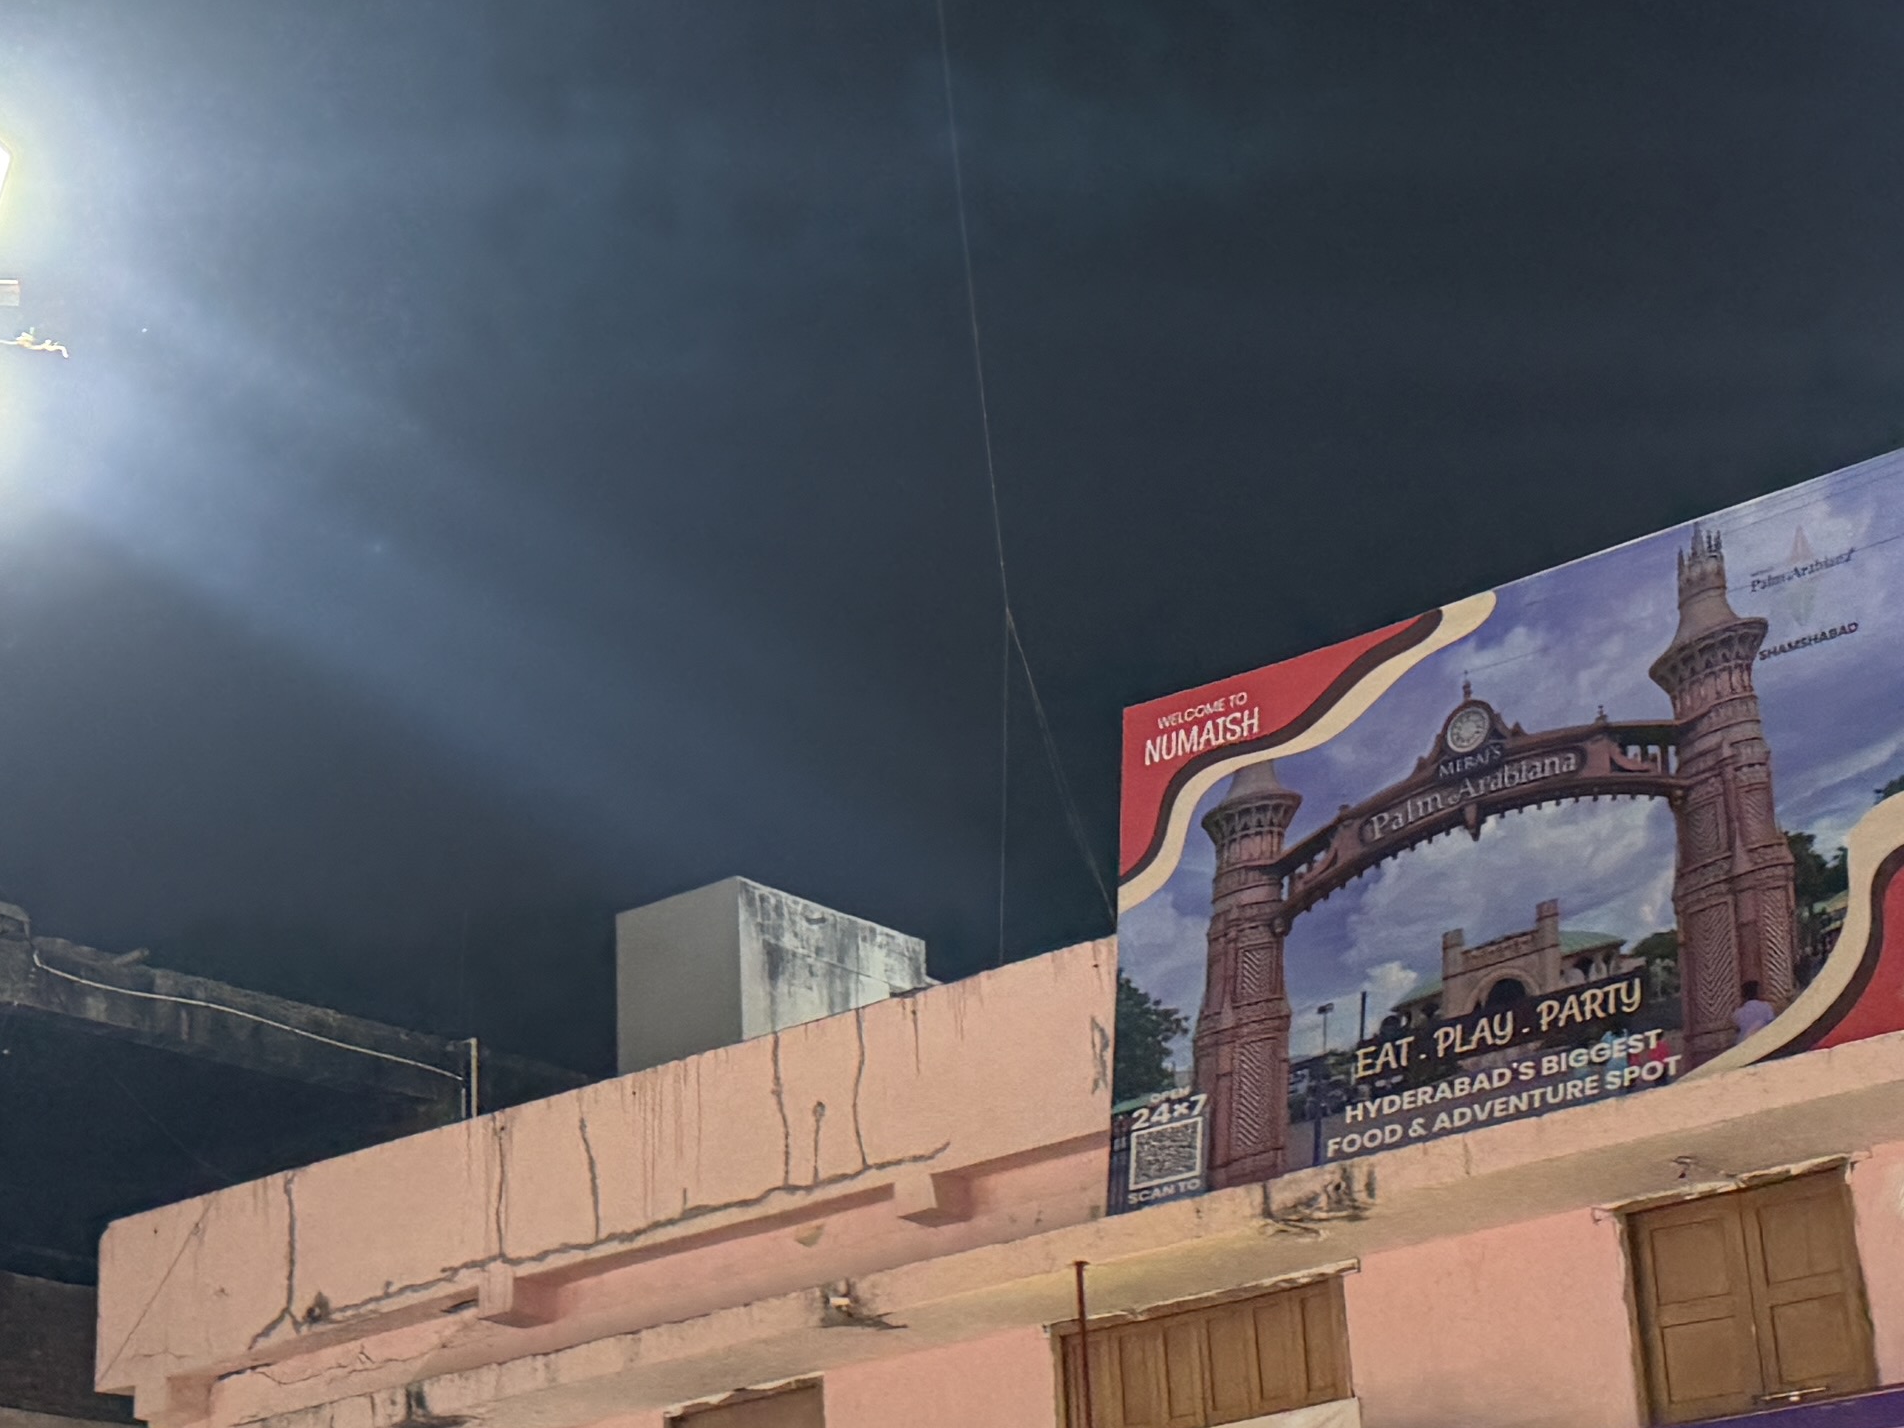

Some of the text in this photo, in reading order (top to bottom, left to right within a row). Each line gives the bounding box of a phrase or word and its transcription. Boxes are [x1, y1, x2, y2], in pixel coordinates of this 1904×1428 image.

[1144, 706, 1259, 766] NUMAISH
[1157, 691, 1248, 729] WELCOME TO
[1368, 752, 1577, 841] Palm Arabiana
[1354, 977, 1642, 1079] EAT PLAY PARTY
[1326, 1054, 1682, 1158] FOOD & ADVENTURE SPOT
[1345, 1028, 1663, 1124] HYDERABAD'S BIGGEST
[1128, 1178, 1201, 1204] SCAN TO
